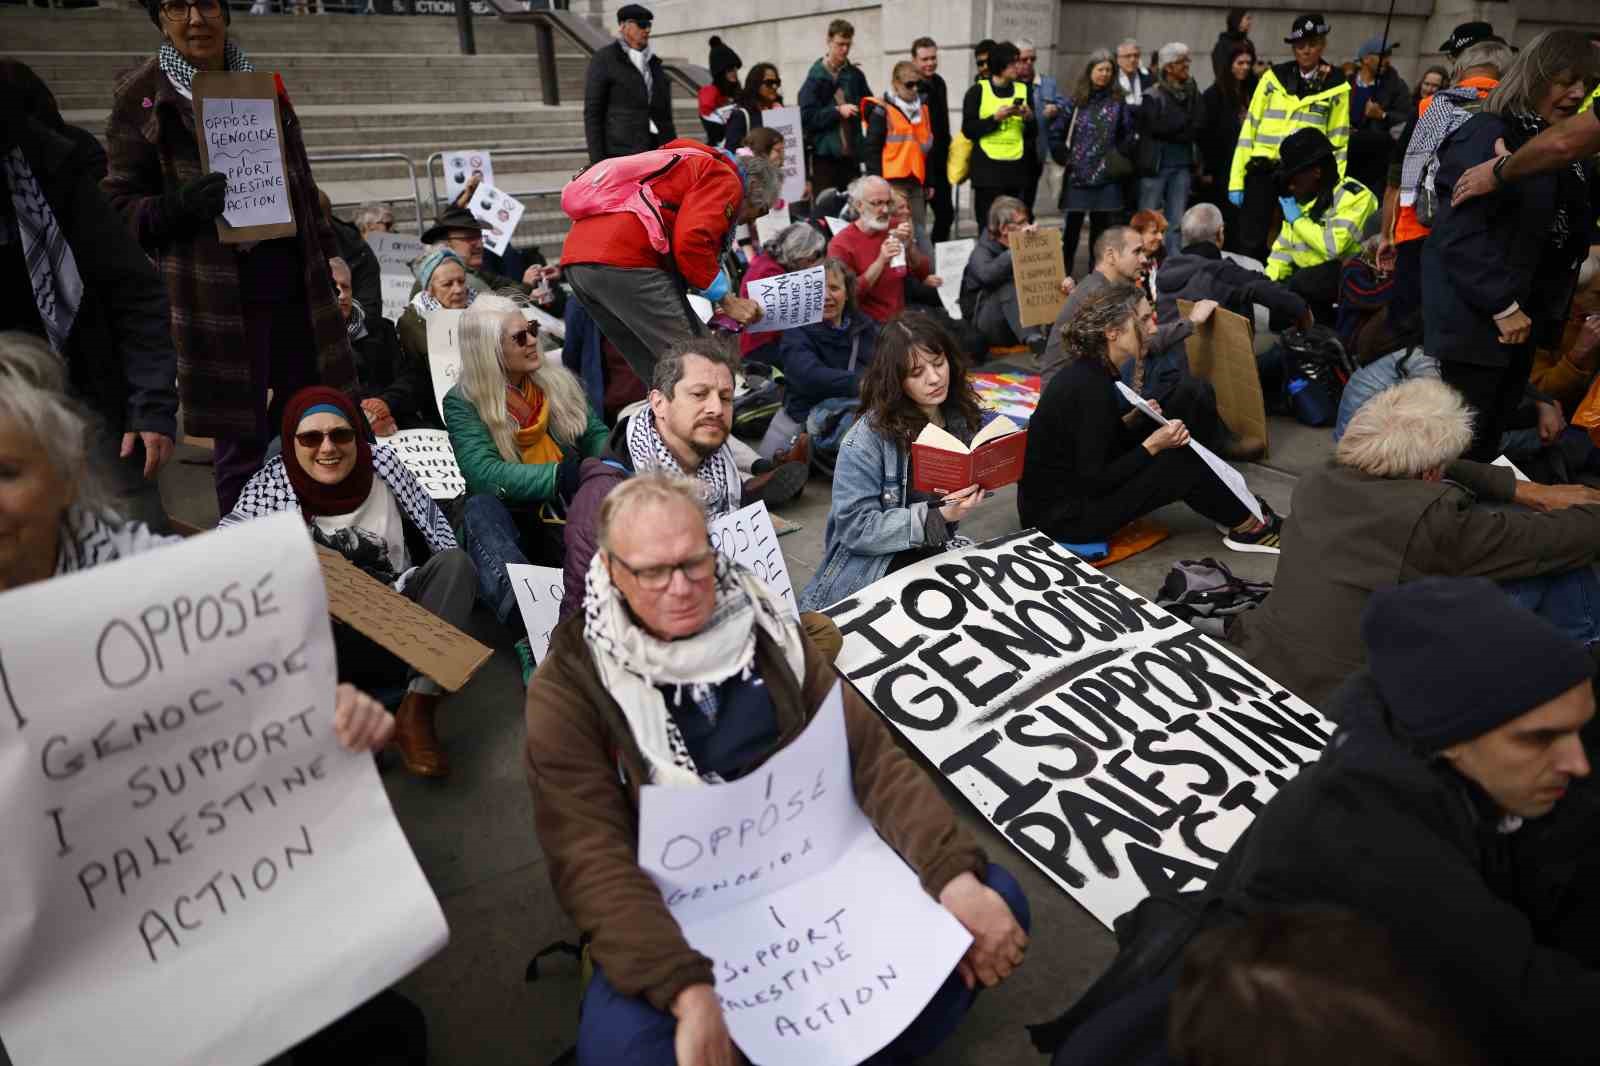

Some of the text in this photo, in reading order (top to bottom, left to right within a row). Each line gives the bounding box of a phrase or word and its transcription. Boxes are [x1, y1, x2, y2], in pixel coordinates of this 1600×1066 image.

[414, 0, 456, 13] CTION
[205, 114, 257, 129] OPPOSE
[211, 128, 277, 148] GENOCIDE
[226, 176, 283, 194] ALESTINE
[227, 197, 276, 211] ACTION
[228, 160, 272, 179] PPORT
[97, 572, 280, 689] OPPOSE
[840, 537, 1117, 681] I OPPOSE
[873, 580, 1178, 731] GENOCIDE
[42, 641, 310, 781] GENOCIDE
[939, 629, 1272, 825] I SUPPORT
[45, 706, 316, 858] I SUPPORT
[661, 768, 827, 871] OPPOSE
[764, 771, 774, 801] I
[77, 754, 327, 910] PALESTINE
[1125, 771, 1288, 897] ACT
[139, 825, 314, 962] ACTION
[769, 905, 786, 929] I
[724, 907, 846, 984] SUPPORT
[775, 964, 897, 1036] ACTION
